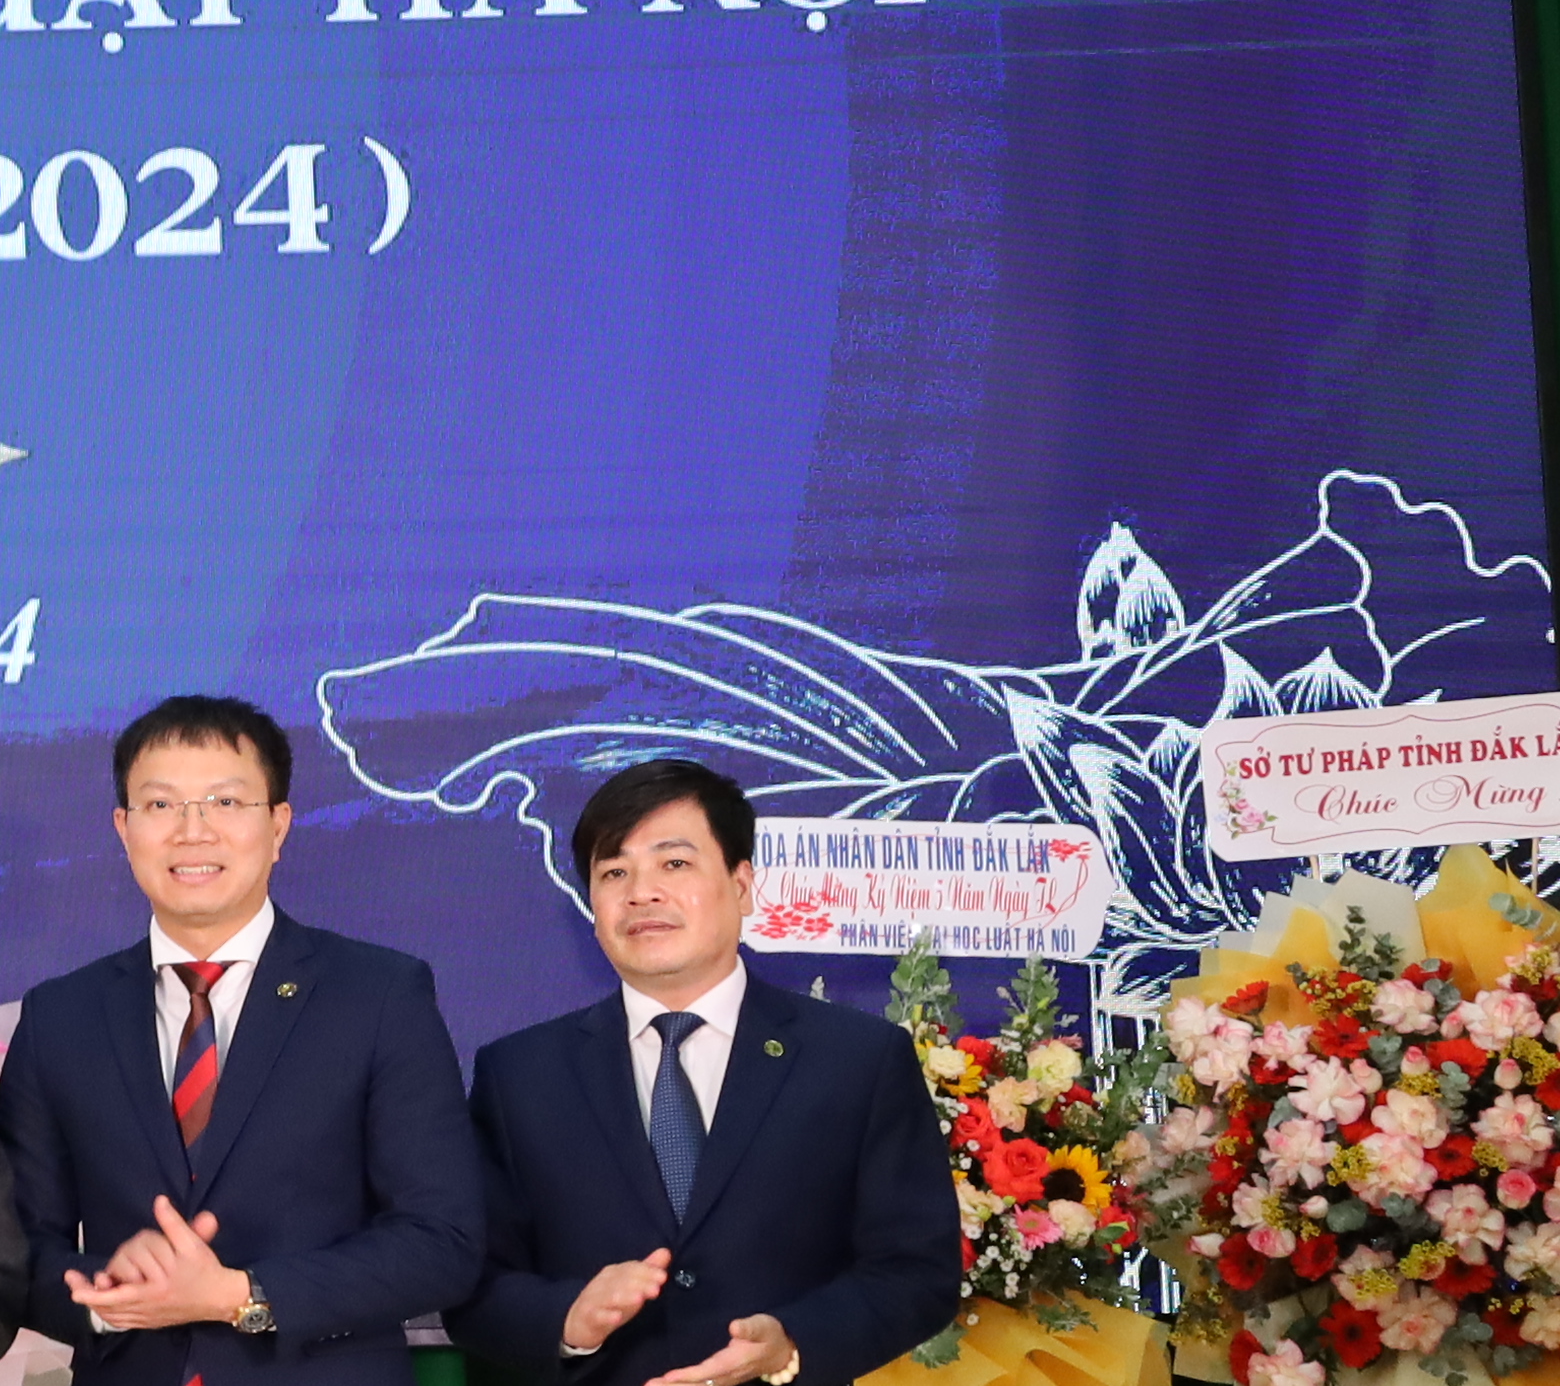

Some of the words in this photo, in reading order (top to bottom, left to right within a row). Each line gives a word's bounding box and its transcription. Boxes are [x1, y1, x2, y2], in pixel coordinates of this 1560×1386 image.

[1239, 745, 1271, 780] SỞ
[1279, 747, 1316, 777] TƯ
[1321, 741, 1392, 774] PHÁP
[1398, 734, 1463, 768] TỈNH
[1470, 725, 1530, 762] ĐẮK
[1294, 783, 1399, 825] Chúc
[1413, 774, 1547, 814] Mừng
[795, 824, 820, 869] ÁN
[826, 826, 876, 870] NHÂN
[882, 827, 920, 871] DÂN
[925, 825, 966, 872] TỈNH
[972, 823, 1010, 873] ĐẮK
[1016, 823, 1052, 874] LẮK
[1051, 923, 1076, 958] NỘI
